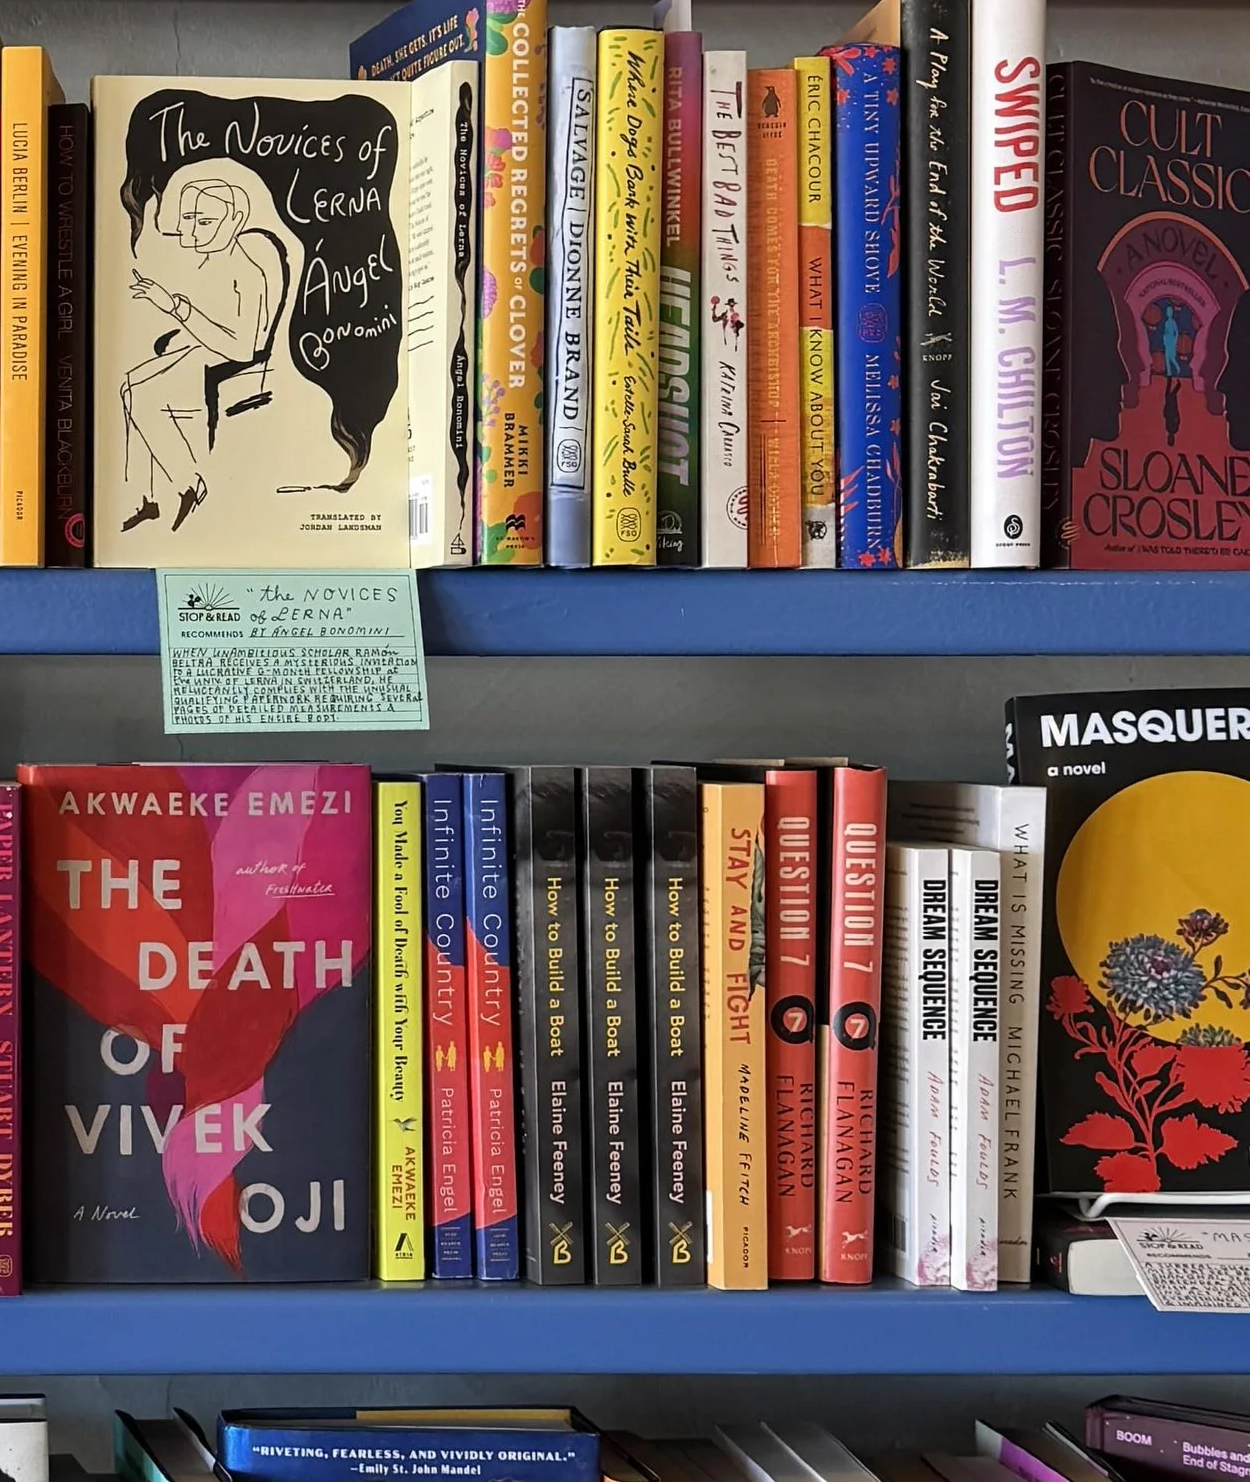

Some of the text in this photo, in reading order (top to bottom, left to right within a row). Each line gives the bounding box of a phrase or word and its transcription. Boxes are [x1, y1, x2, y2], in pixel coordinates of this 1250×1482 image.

[149, 102, 211, 161] The
[358, 126, 392, 178] of
[994, 55, 1041, 213] SWIPED
[1120, 100, 1223, 157] CULT
[997, 258, 1036, 479] L. M. CHILTON
[1100, 447, 1250, 496] SLOANE
[304, 588, 397, 602] NOVICES
[181, 630, 243, 638] RECOMMENDS
[1048, 762, 1106, 776] a novel
[60, 791, 352, 816] AKWAEKE EMEZI
[57, 859, 183, 910] THE
[843, 823, 877, 974] QUESTION 7
[138, 939, 353, 991] DEATH
[101, 1024, 186, 1075] OF
[65, 1103, 273, 1156] VIVEK
[836, 1080, 855, 1203] FLANAGAN
[858, 1089, 872, 1194] RICHARD
[240, 1179, 346, 1233] OJI
[332, 1449, 405, 1460] FEARLESS,
[409, 1450, 436, 1460] AND
[441, 1450, 494, 1460] VIVIDLY
